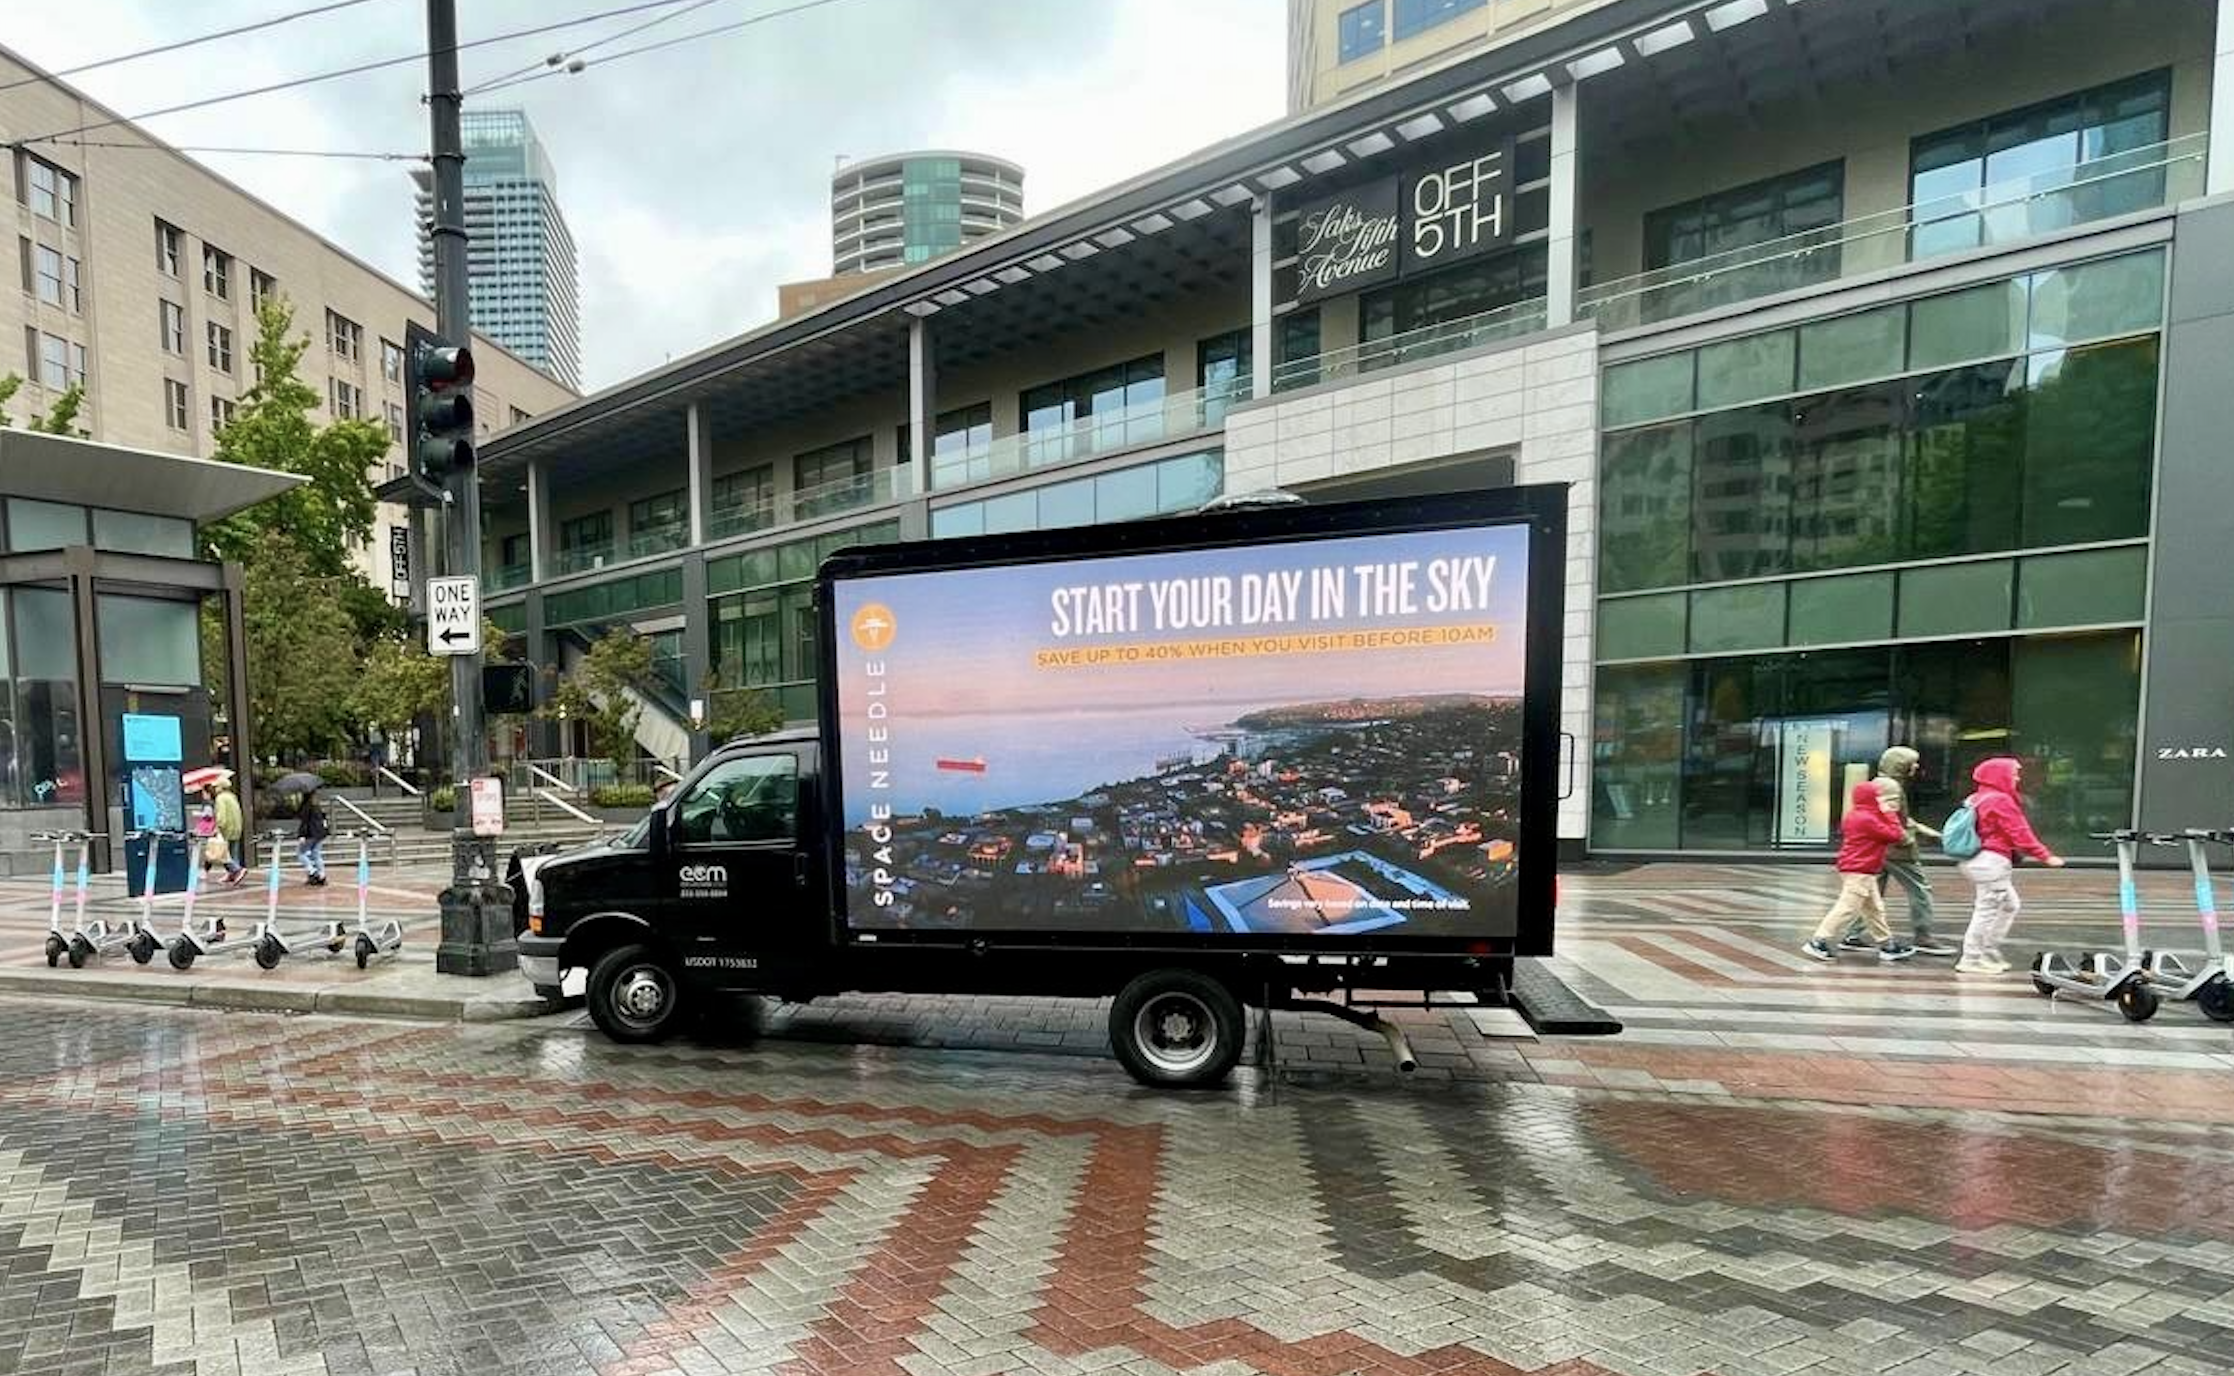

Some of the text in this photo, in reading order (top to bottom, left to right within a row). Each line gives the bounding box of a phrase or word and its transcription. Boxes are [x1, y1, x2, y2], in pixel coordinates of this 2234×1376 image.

[1414, 152, 1502, 217] OFF
[1299, 204, 1363, 254] Saks
[1414, 195, 1501, 257] 5TH
[1298, 248, 1389, 294] Avenue
[434, 606, 470, 623] WAY
[435, 584, 470, 604] ONE
[1051, 555, 1496, 636] START YOUR DAY IN THE SKY
[1037, 626, 1494, 666] SAVE UP TO 40% WHEN YOU VISIT BEFORE 10AM
[2158, 747, 2227, 759] ZARA
[867, 660, 893, 907] SPACE NEEDLE
[1794, 734, 1809, 837] NEW SEASON
